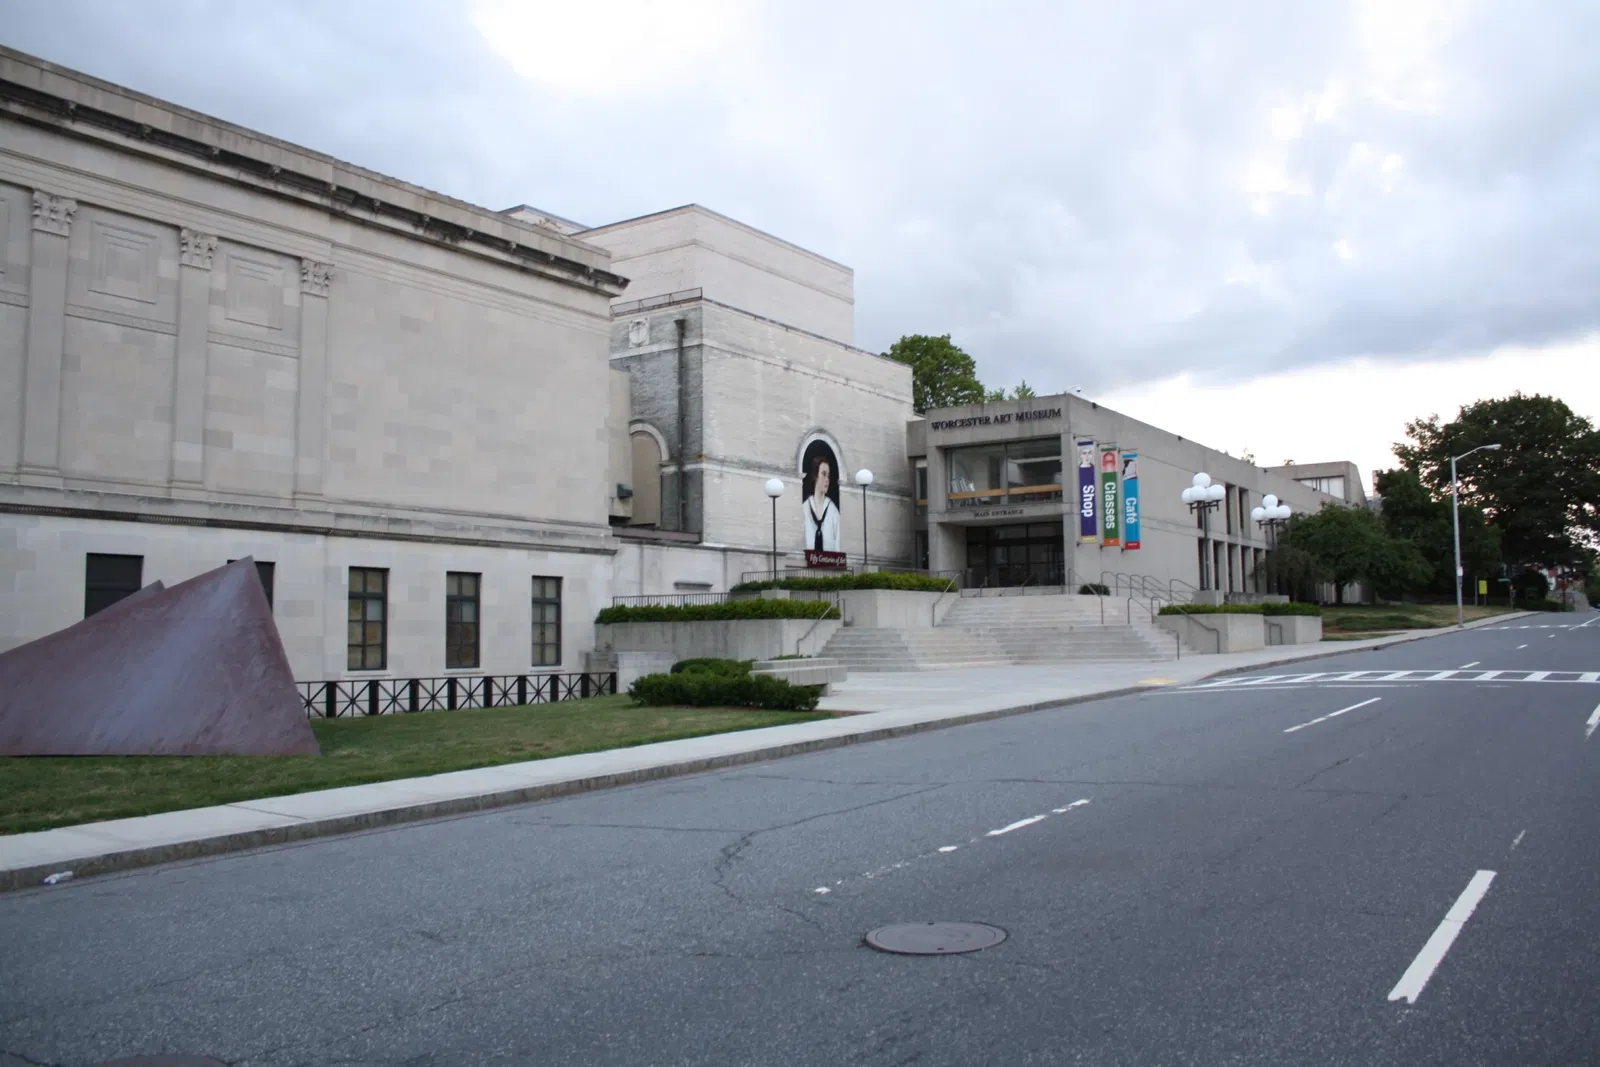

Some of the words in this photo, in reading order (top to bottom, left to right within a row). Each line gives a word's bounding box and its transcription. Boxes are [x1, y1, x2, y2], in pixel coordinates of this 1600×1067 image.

[931, 416, 991, 431] WORCESTER
[993, 413, 1013, 424] ART
[1015, 408, 1062, 421] MUSEUM
[1081, 485, 1094, 517] Shop
[1104, 482, 1116, 529] Classes
[1125, 497, 1137, 523] Café
